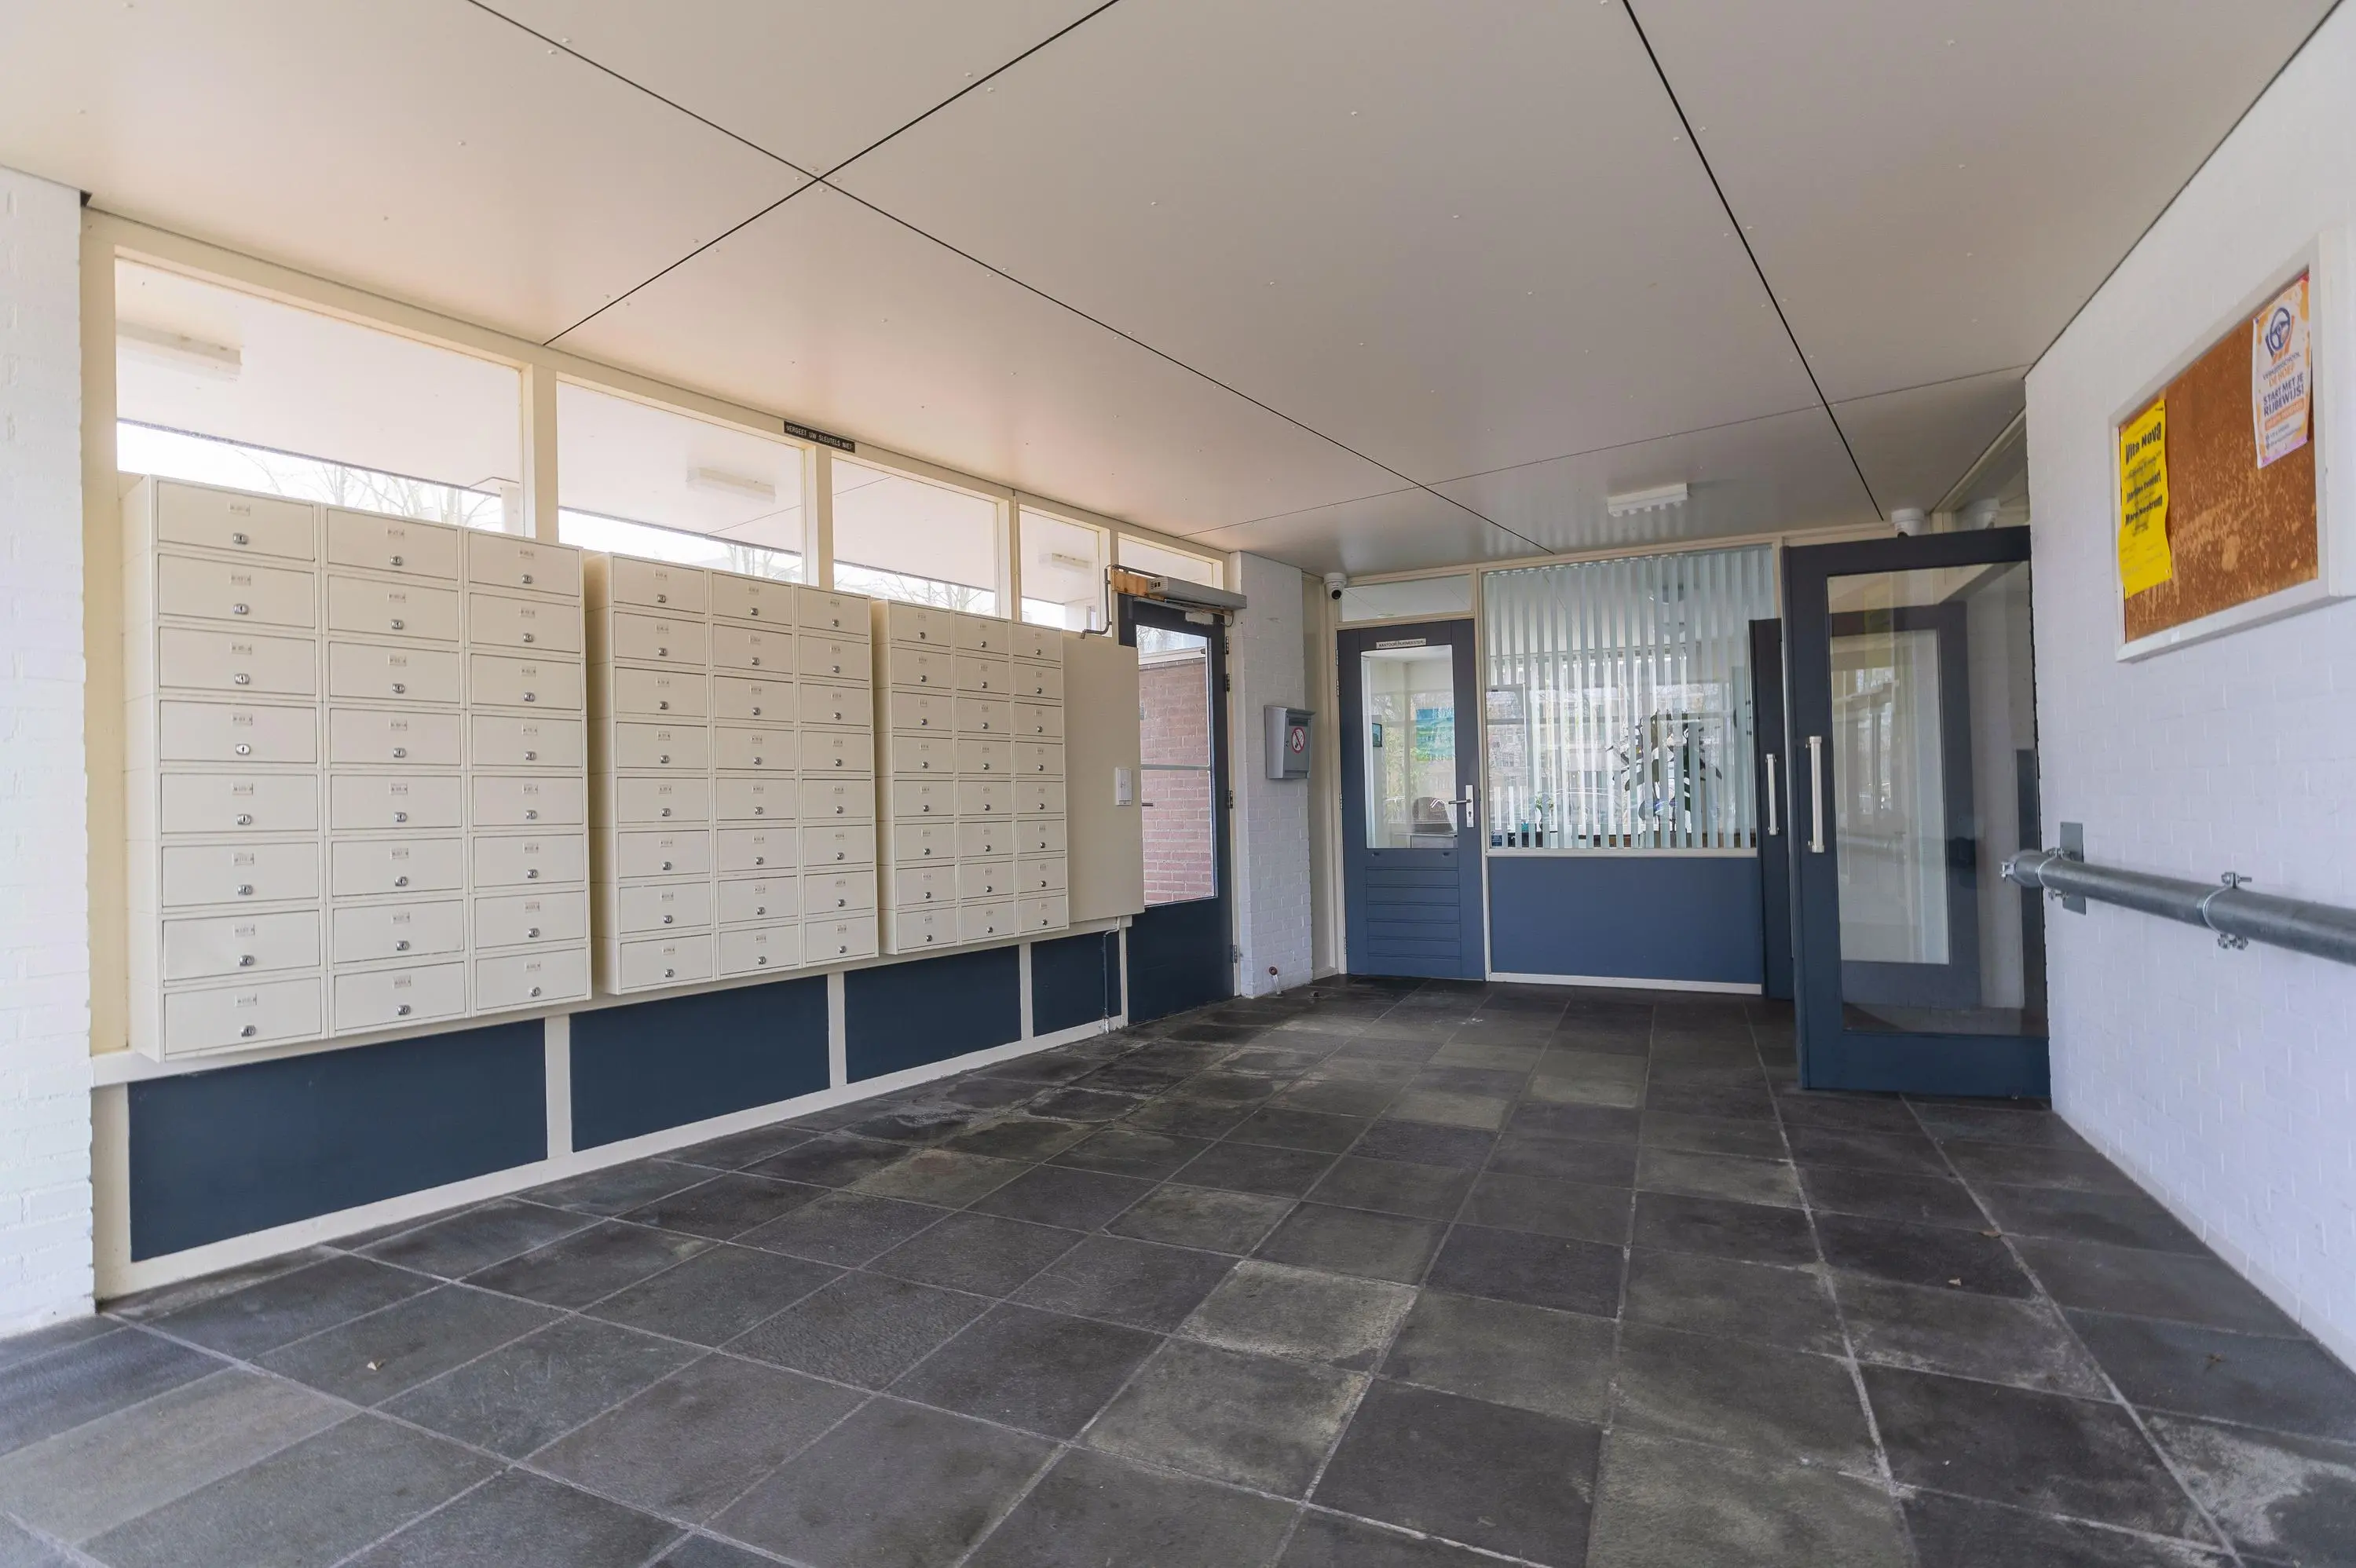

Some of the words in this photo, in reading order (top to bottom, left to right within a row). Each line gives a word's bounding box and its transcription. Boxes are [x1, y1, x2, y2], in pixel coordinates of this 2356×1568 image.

[2263, 386, 2281, 405] START
[2282, 377, 2296, 391] MET
[2297, 371, 2303, 385] JE
[786, 424, 807, 437] VERGEET
[809, 431, 818, 440] UW
[818, 434, 841, 447] SLEUTELS
[842, 441, 853, 450] NIET
